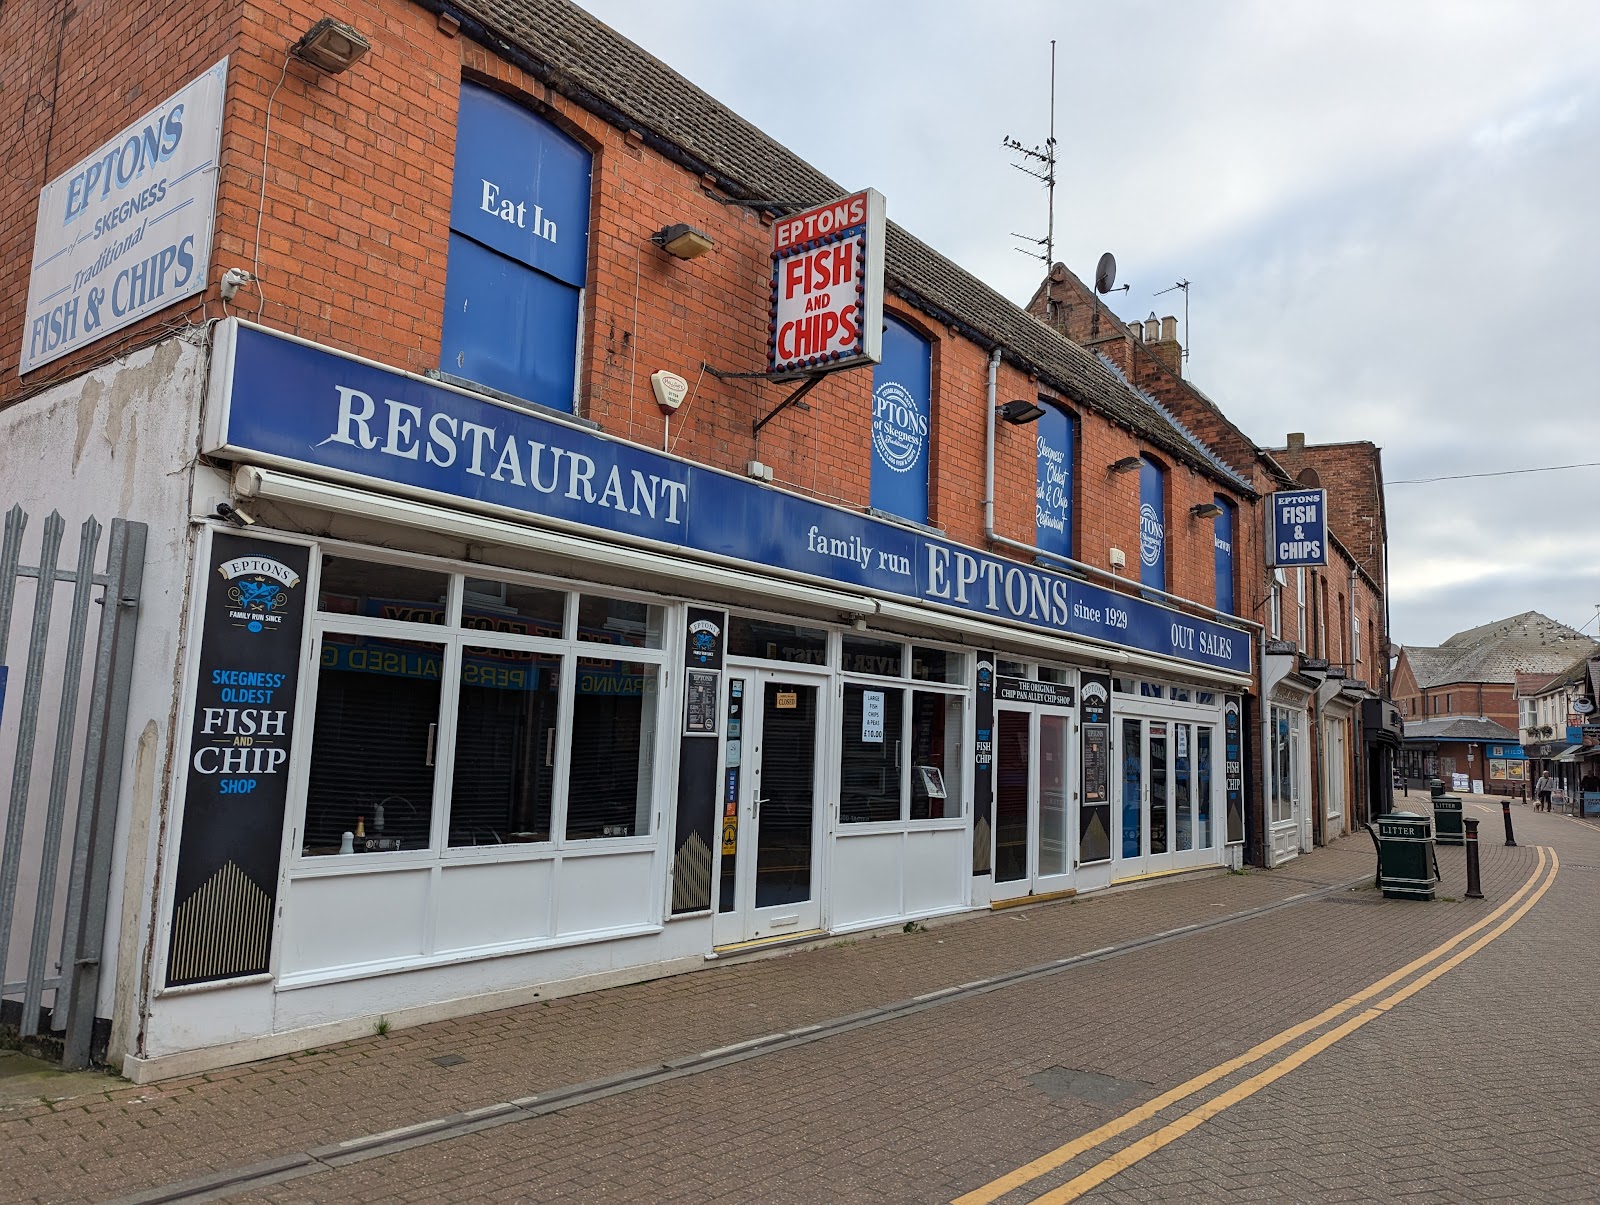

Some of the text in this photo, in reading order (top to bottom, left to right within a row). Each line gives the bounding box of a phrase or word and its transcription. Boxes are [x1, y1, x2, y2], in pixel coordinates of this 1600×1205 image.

[64, 103, 185, 227] EPTONS
[93, 178, 167, 241] SKEGNESS
[479, 179, 558, 244] Eat In
[777, 198, 865, 248] EPTONS
[73, 219, 148, 294] Traditional
[785, 242, 853, 301] FISH
[28, 234, 195, 361] FISH & CHIPS
[804, 293, 831, 314] AND
[777, 304, 857, 360] CHIPS
[873, 420, 919, 446] of Skegness
[312, 384, 687, 526] RESTAURANT
[1046, 462, 1070, 488] Oldest
[1036, 480, 1068, 517] ish & Chip
[1277, 494, 1321, 505] EPTONS
[1035, 504, 1069, 535] Restaurant
[1282, 505, 1317, 524] FISH
[1140, 515, 1164, 539] PTONS
[1293, 525, 1305, 540] &
[1214, 533, 1231, 556] keaway
[1279, 541, 1321, 560] CHIPS
[231, 560, 290, 580] EPTONS
[807, 526, 1128, 630] family run EPTONS since 1929
[229, 610, 282, 623] FAMILY RUN SINCE
[693, 623, 717, 634] EPTONS
[1170, 623, 1233, 661] OUT SALES
[211, 669, 286, 688] SKEGNESS'
[693, 674, 713, 682] EPTONS
[1018, 681, 1057, 694] THE ORIGINAL
[221, 687, 274, 704] OLDEST
[1001, 689, 1071, 704] CHIP PAN ALLEY CHIP SHOP
[1084, 683, 1106, 698] EPTONS
[200, 707, 288, 736] FISH
[233, 736, 253, 746] AND
[863, 730, 883, 738] £10.00
[976, 742, 991, 751] FISH
[193, 746, 287, 775] CHIP
[975, 754, 992, 764] CHIP
[1226, 761, 1240, 774] FISH
[219, 779, 257, 794] SHOP
[1226, 778, 1240, 791] CHIP
[1382, 825, 1416, 836] LITTER
